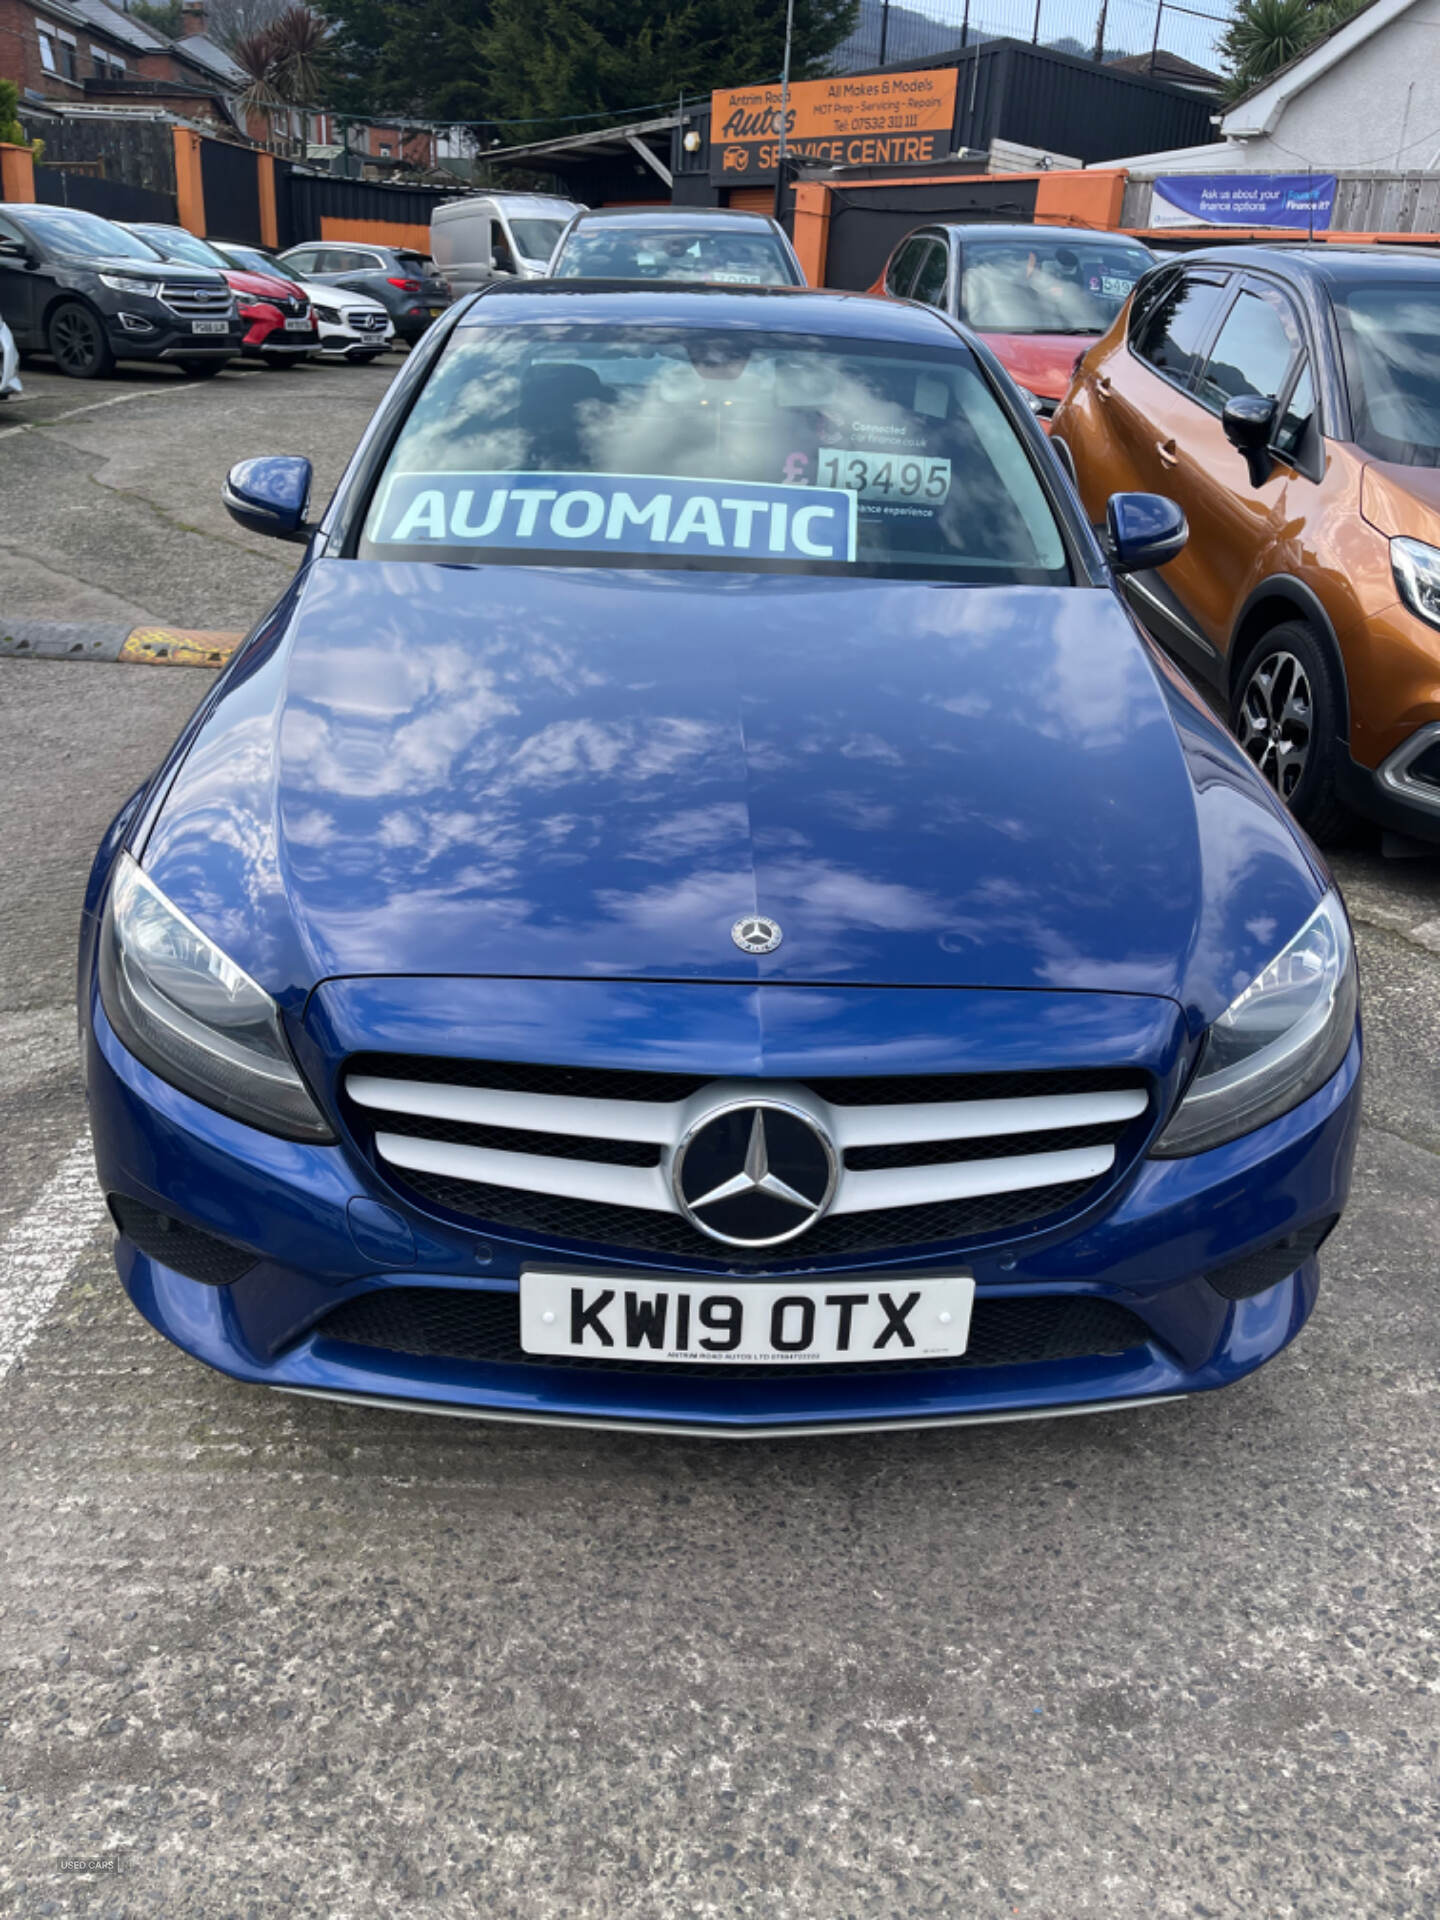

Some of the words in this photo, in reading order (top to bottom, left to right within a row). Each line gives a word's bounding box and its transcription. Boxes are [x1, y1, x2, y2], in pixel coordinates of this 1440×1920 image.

[828, 85, 840, 97] All
[844, 83, 879, 97] Makes
[892, 79, 933, 93] Models
[729, 94, 762, 106] Antrim
[813, 104, 832, 115] MOT
[861, 99, 899, 112] Servicing
[908, 97, 942, 109] Repairs
[722, 106, 796, 138] Autos
[847, 136, 934, 164] CENTRE
[1201, 189, 1218, 199] Ask
[1220, 190, 1230, 199] us
[1232, 189, 1258, 199] about
[1260, 190, 1280, 202] your
[1200, 200, 1231, 211] finance
[1232, 201, 1266, 213] options
[1103, 279, 1134, 295] 549
[782, 452, 809, 486] £
[824, 457, 948, 498] 13495
[391, 488, 835, 558] AUTOMATIC
[570, 1287, 743, 1352] KW19
[770, 1291, 921, 1351] OTX
